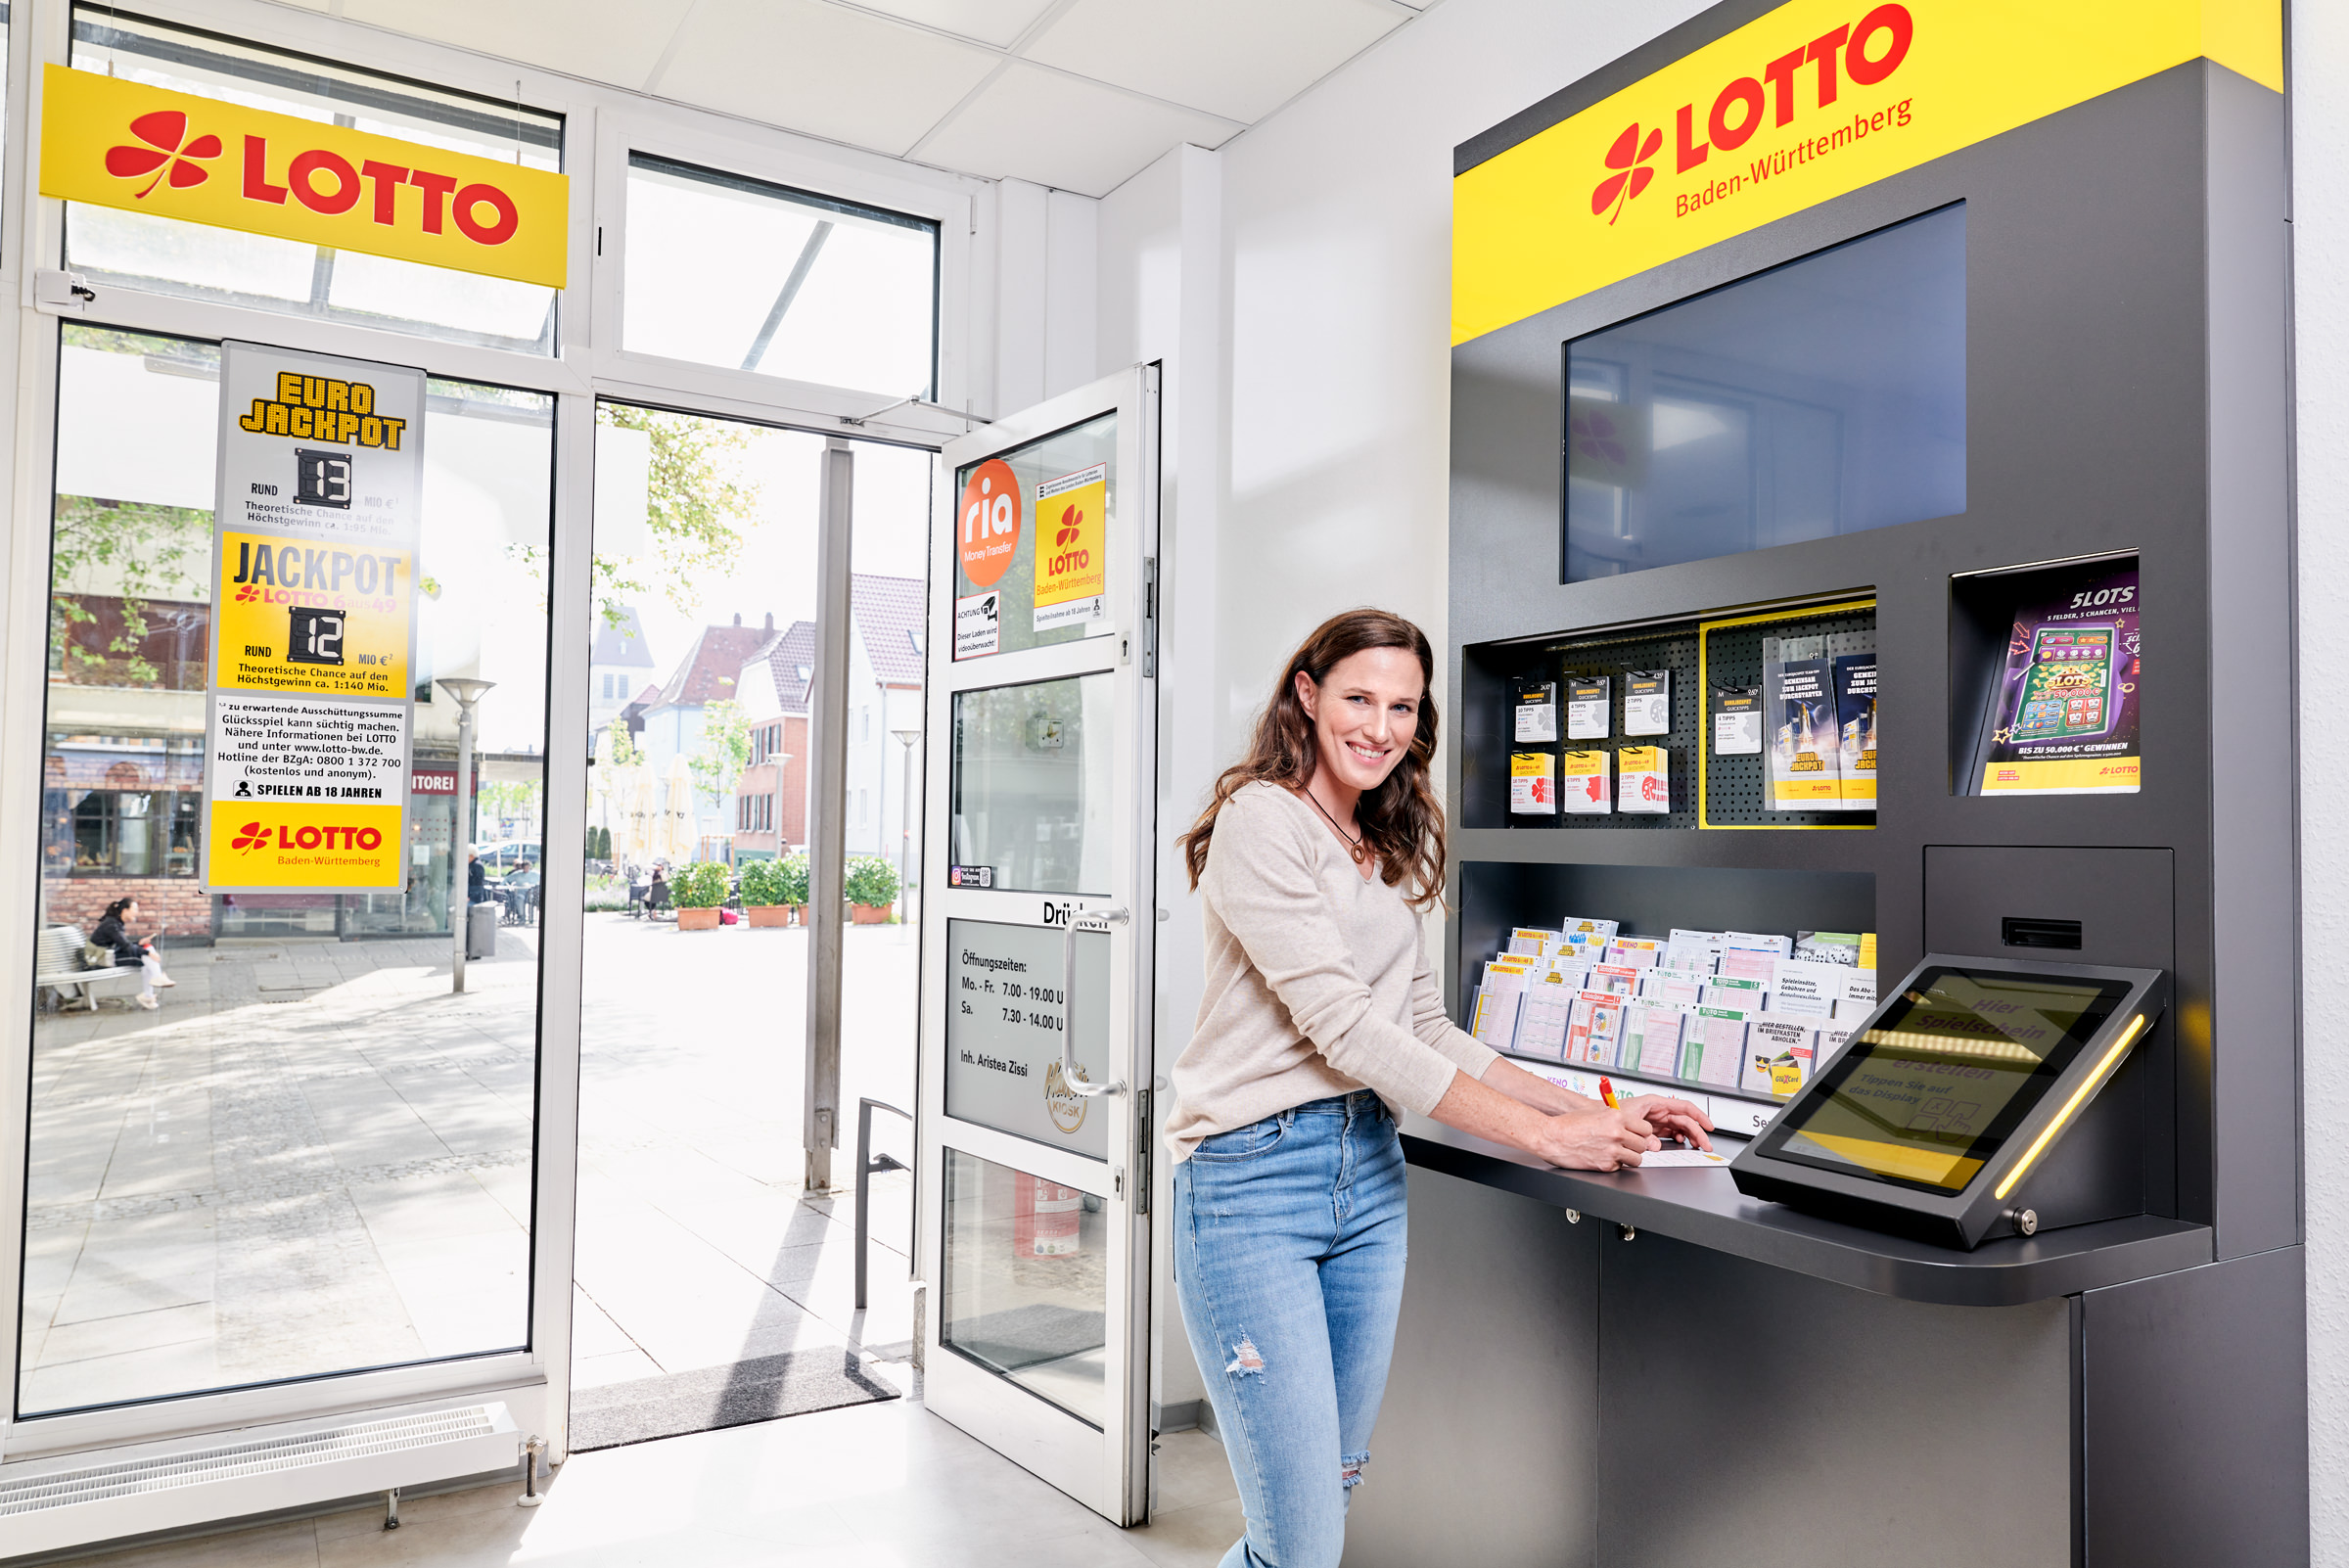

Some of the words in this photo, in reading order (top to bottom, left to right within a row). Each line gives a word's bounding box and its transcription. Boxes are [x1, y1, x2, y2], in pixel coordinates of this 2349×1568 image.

[1676, 3, 1913, 175] LOTTO
[1677, 97, 1912, 218] Baden-Württemberg
[242, 134, 519, 246] LOTTO
[277, 371, 375, 415] EURO
[239, 398, 407, 451] JACKPOT
[251, 483, 278, 496] RUND
[316, 459, 351, 501] 13
[364, 496, 383, 508] MIO
[245, 500, 313, 517] Theoretische
[316, 508, 352, 522] Chance
[355, 514, 373, 523] auf
[376, 515, 393, 526] den
[965, 477, 1014, 544] ria
[247, 512, 321, 528] Höchstgewinn
[344, 523, 366, 532] 1:95
[370, 525, 392, 535] Mio.
[964, 548, 987, 563] Money
[986, 542, 1012, 558] Transfer
[1048, 548, 1089, 577] LOTTO
[234, 542, 401, 596] JACKPOT
[1036, 572, 1102, 596] Baden-Württemberg
[264, 588, 328, 608] LOTTO
[957, 607, 981, 621] ACHTUNG
[2052, 612, 2079, 621] FELDER,
[2085, 608, 2119, 618] CHANCEN,
[245, 645, 272, 658] RUND
[307, 617, 344, 658] 12
[358, 653, 377, 666] MIO
[957, 631, 971, 641] Dieser
[971, 628, 987, 639] Laden
[987, 626, 997, 635] wird
[958, 639, 996, 653] videoüberwacht!
[239, 664, 306, 676] Theoretische
[310, 669, 346, 678] Chance
[349, 670, 367, 680] auf
[369, 671, 389, 681] den
[237, 674, 311, 687] Höchstgewinn
[315, 680, 330, 689] ca.
[335, 680, 363, 690] 1:140
[367, 682, 389, 692] Mio.
[242, 705, 299, 715] erwartende
[300, 707, 403, 719] Ausschüttungssumme
[222, 715, 284, 728] Glücksspiel
[287, 718, 313, 728] kann
[316, 719, 354, 732] süchtig
[357, 722, 399, 732] machen.
[225, 727, 263, 738] Nähere
[266, 729, 344, 741] Informationen
[346, 733, 362, 742] bei
[366, 735, 396, 744] LOTTO
[238, 741, 258, 750] und
[294, 744, 384, 755] www.lotto-bw.de.
[2084, 742, 2129, 752] GEWINNEN
[217, 752, 258, 762] Hotline
[261, 755, 280, 763] der
[283, 756, 313, 766] BZgA:
[316, 757, 345, 765] 0800
[348, 758, 354, 766] 1
[357, 758, 378, 766] 372
[382, 759, 401, 767] 700
[1789, 760, 1823, 772] JACKPOT
[2110, 765, 2139, 774] LOTTO
[244, 765, 301, 777] (kostenlos
[304, 768, 324, 777] und
[327, 769, 376, 780] anonym).
[257, 784, 303, 797] SPIELEN
[306, 786, 321, 797] AB
[325, 786, 338, 798] 18
[341, 787, 382, 799] JAHREN
[278, 825, 383, 851] LOTTO
[277, 855, 381, 867] Baden-Württemberg
[962, 949, 1027, 973] Öffnungszeiten:
[961, 977, 977, 991] Mo.
[984, 980, 994, 993] Fr.
[1002, 983, 1021, 998] 7.00
[1029, 987, 1054, 1003] 19.00
[1781, 977, 1818, 988] Spieleinsätze,
[961, 1001, 973, 1015] Sa.
[1002, 1008, 1021, 1024] 7.30
[1029, 1012, 1054, 1030] 14.00
[1971, 999, 2025, 1014] Hier
[1765, 1028, 1801, 1038] BRIEFKASTEN
[1914, 1015, 2047, 1040] Spielschein
[960, 1049, 975, 1065] Inh.
[977, 1053, 1007, 1072] Aristea
[1008, 1059, 1028, 1077] Zissi
[1892, 1058, 1996, 1081] erstellen
[1861, 1074, 1904, 1087] Tippen
[1905, 1081, 1926, 1090] Sie
[1927, 1084, 1954, 1094] auf
[1848, 1086, 1870, 1096] das
[1872, 1089, 1922, 1105] Display
[1052, 1101, 1081, 1119] KIOSK
